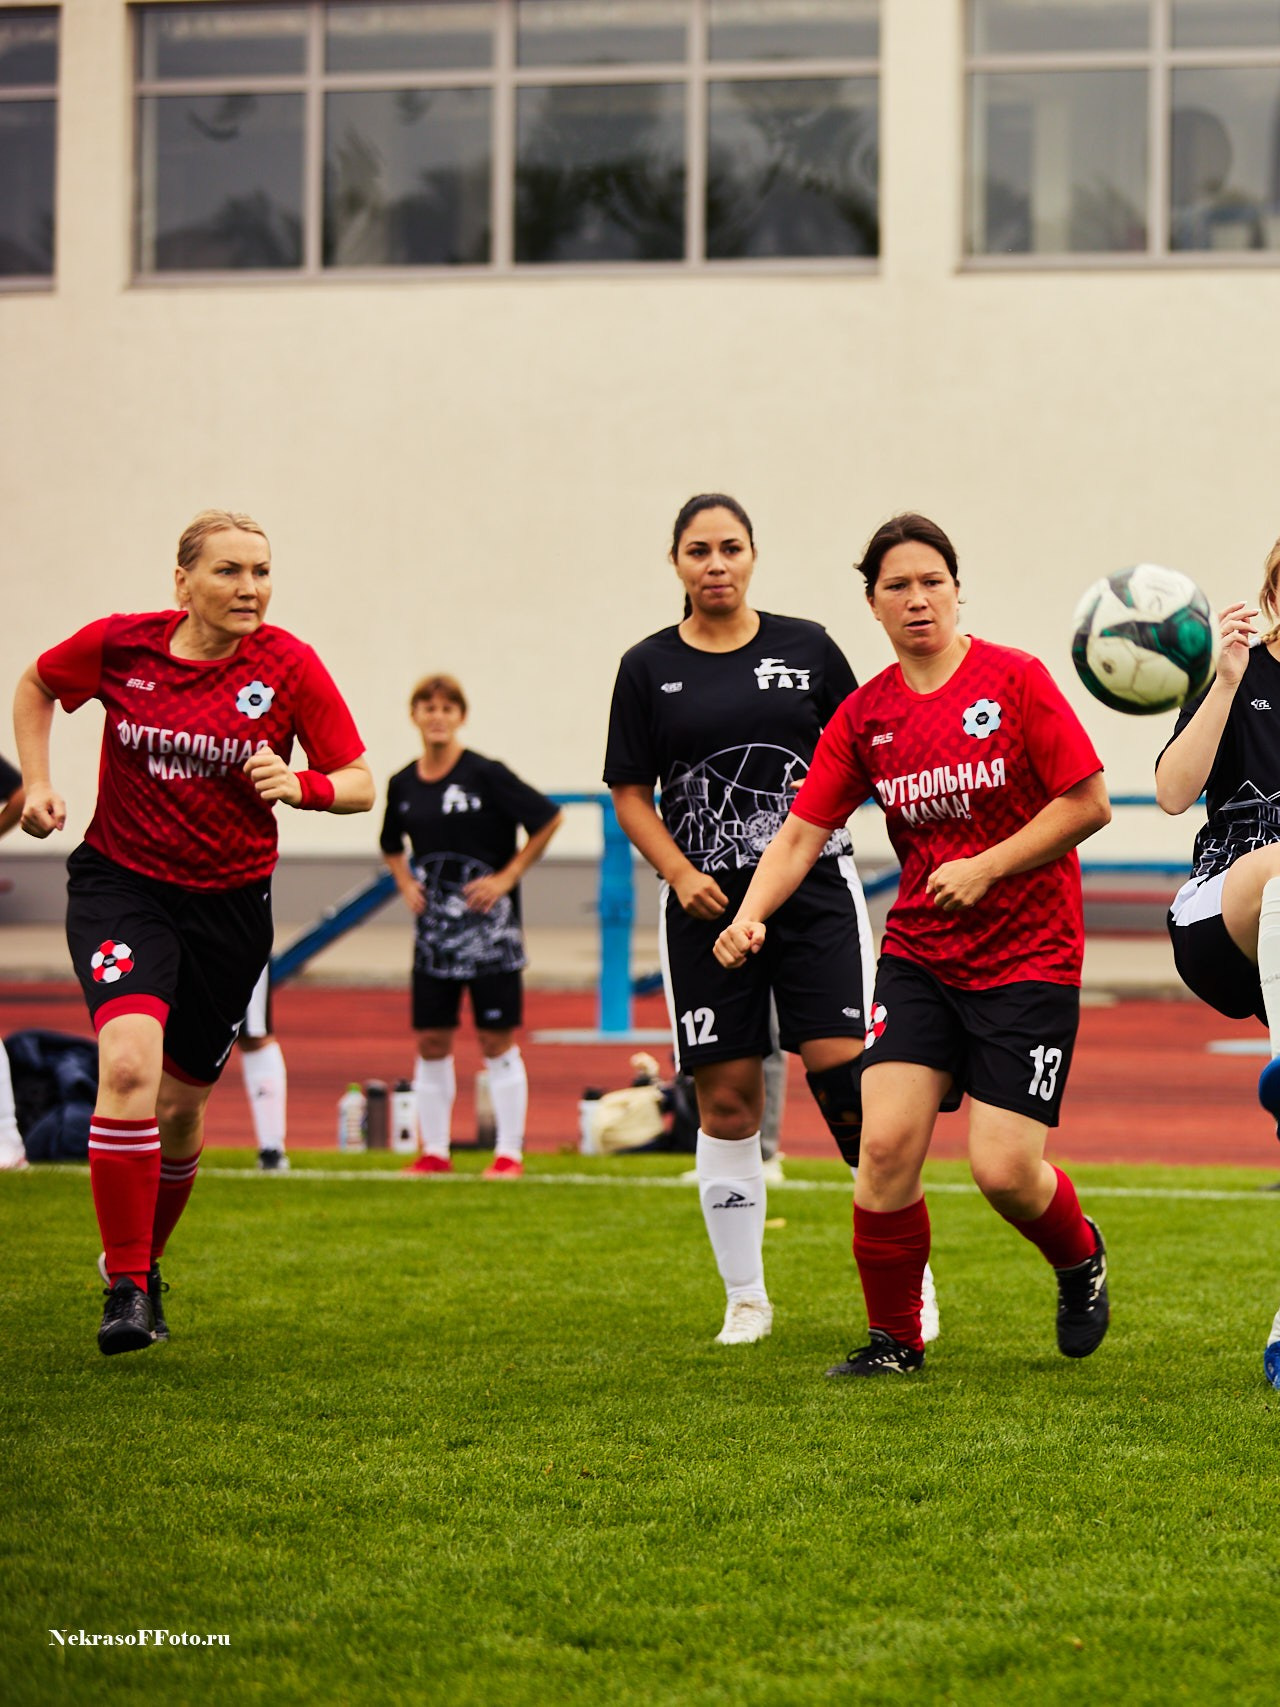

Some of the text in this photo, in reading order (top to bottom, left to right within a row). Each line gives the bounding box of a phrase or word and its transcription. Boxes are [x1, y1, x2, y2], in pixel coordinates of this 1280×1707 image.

[757, 674, 810, 690] ГАЗ
[681, 1007, 719, 1047] 12
[1028, 1045, 1062, 1101] 13
